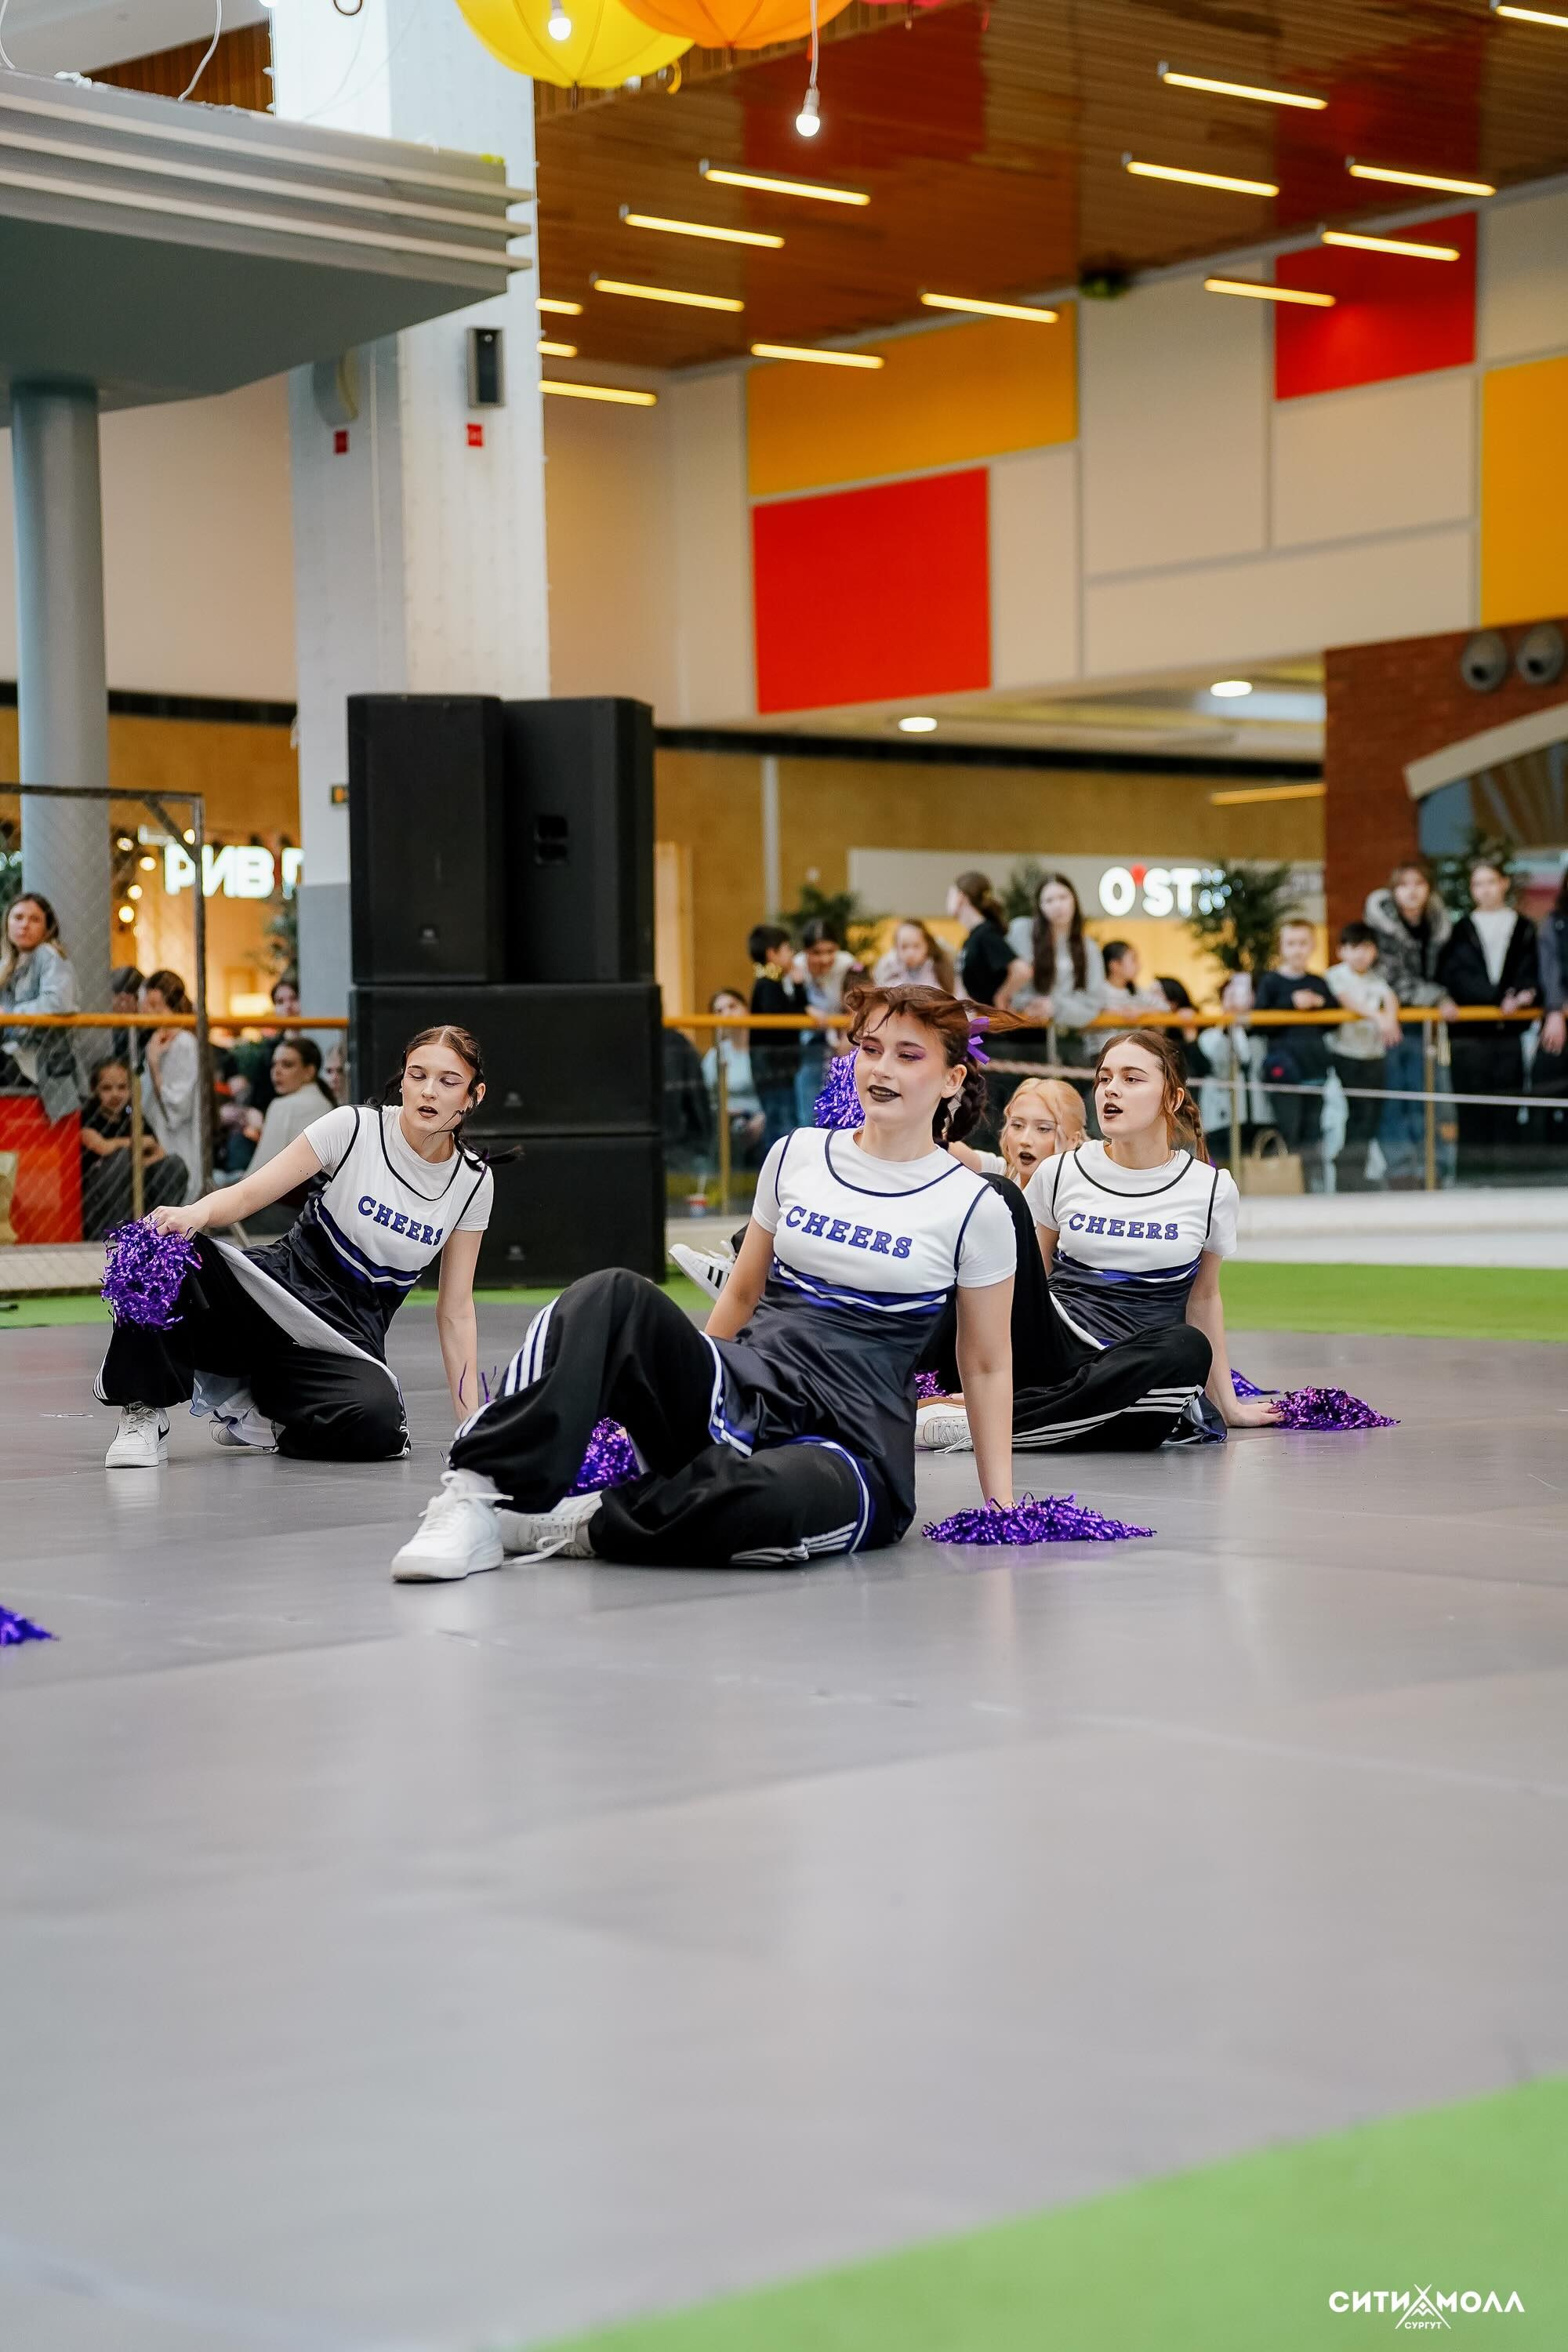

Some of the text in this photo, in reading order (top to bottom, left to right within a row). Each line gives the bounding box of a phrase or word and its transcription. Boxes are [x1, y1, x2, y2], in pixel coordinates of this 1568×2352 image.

[164, 844, 275, 898] РИВ
[1098, 863, 1232, 916] O'ST
[358, 1196, 444, 1247] CHEERS
[786, 1206, 913, 1259] CHEERS
[1069, 1213, 1179, 1240] CHEERS
